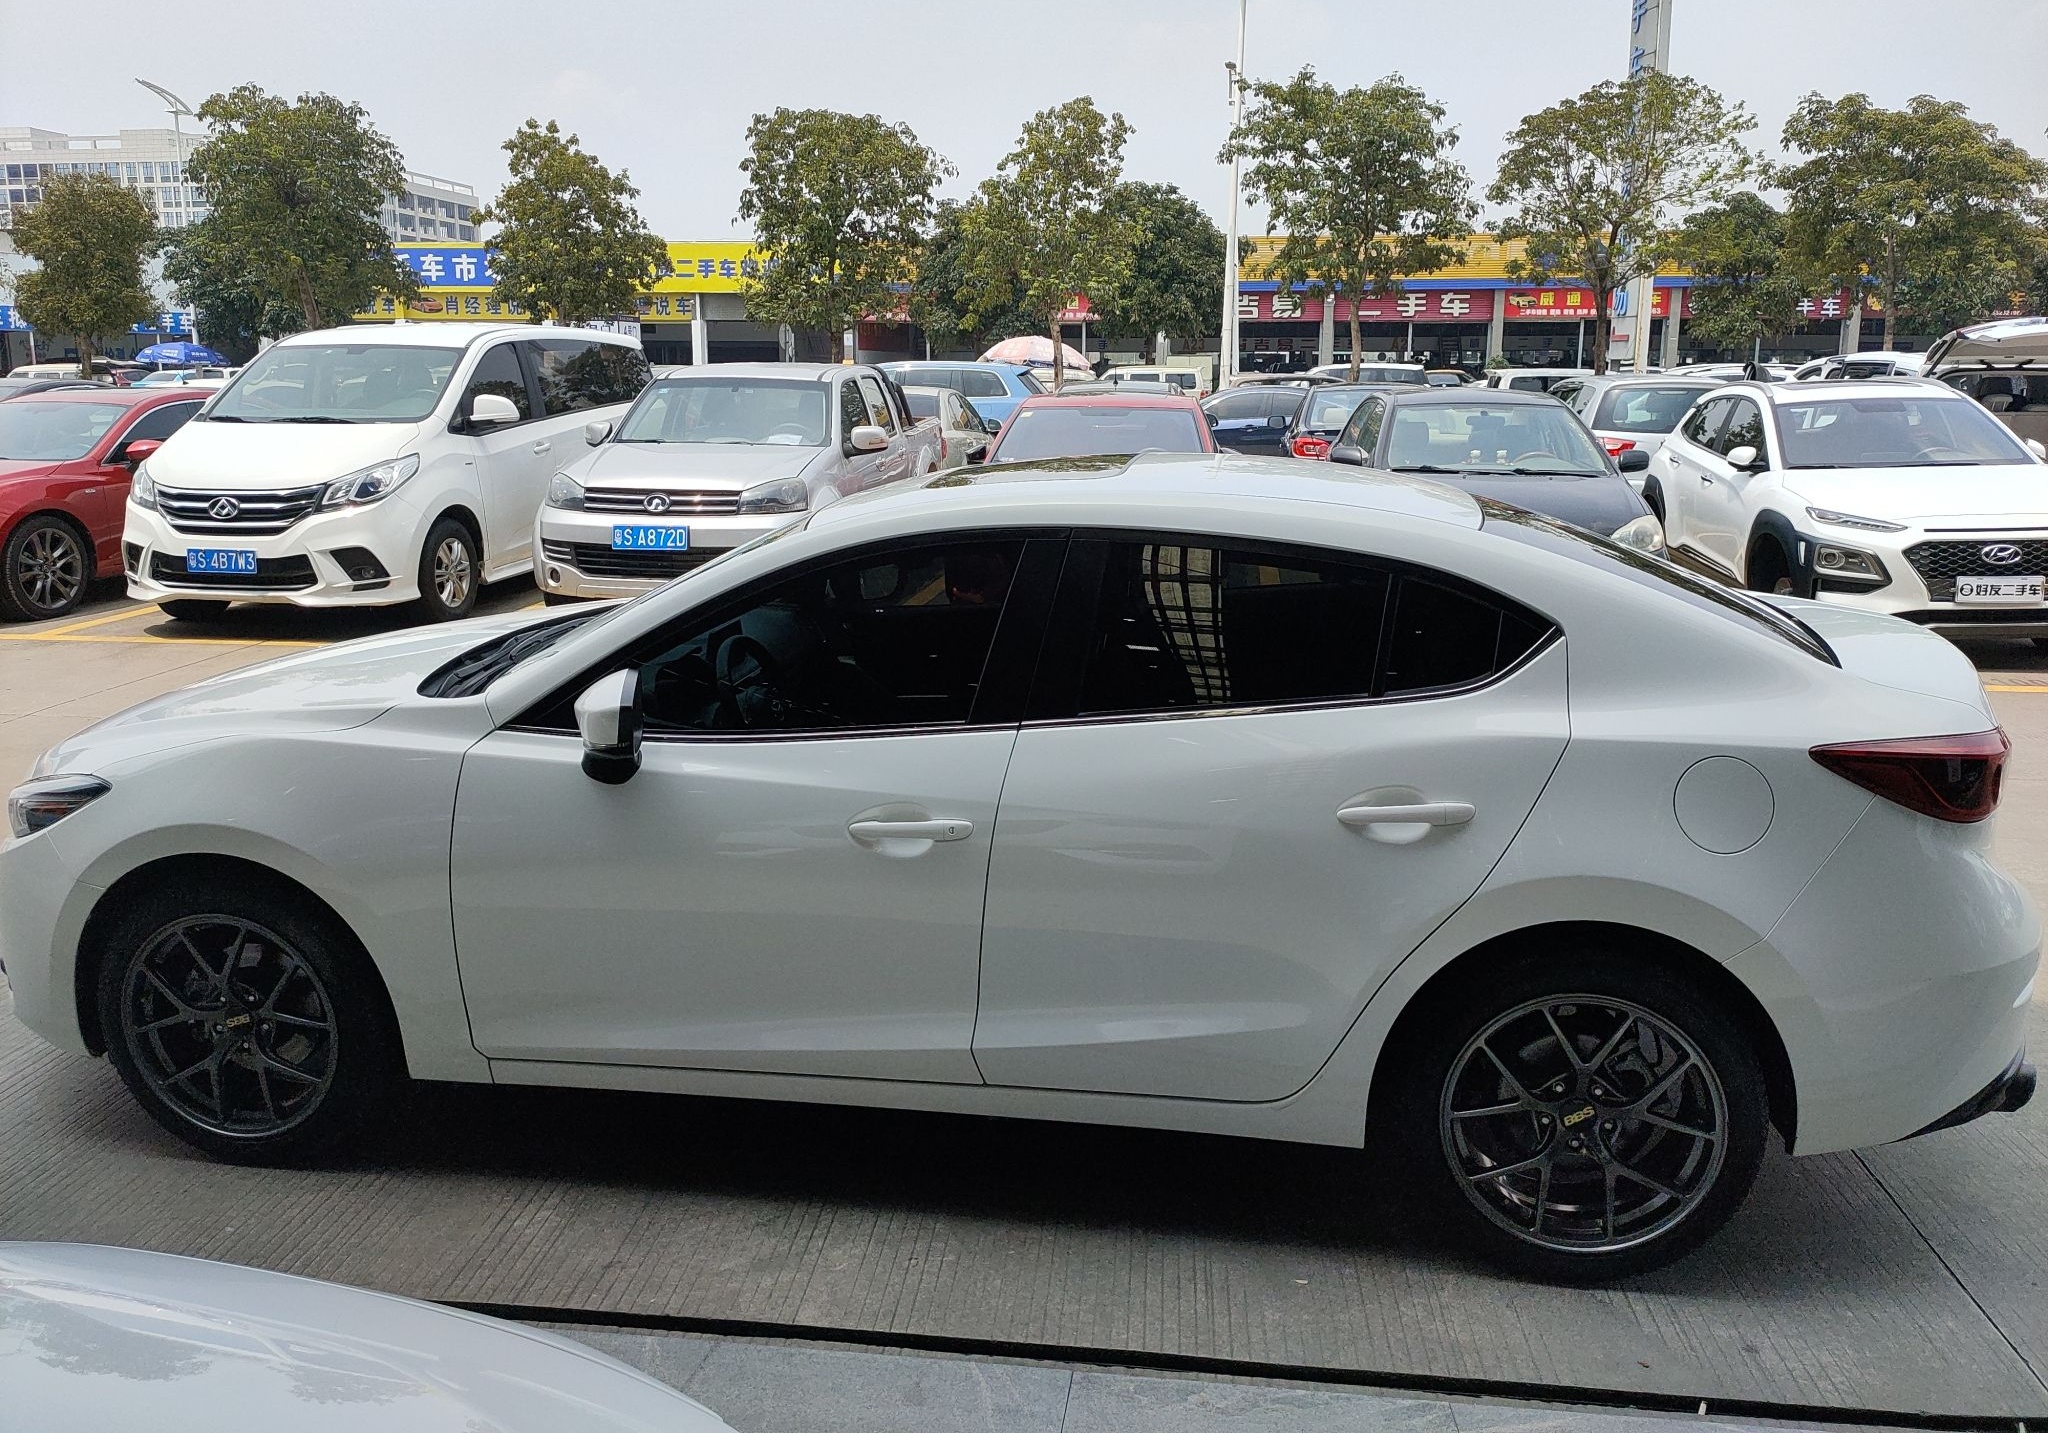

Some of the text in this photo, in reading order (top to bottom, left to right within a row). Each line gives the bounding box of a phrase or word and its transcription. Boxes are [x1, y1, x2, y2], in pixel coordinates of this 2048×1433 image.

[1974, 583, 2041, 597] 好友二手车
[1564, 1106, 1595, 1126] BBS
